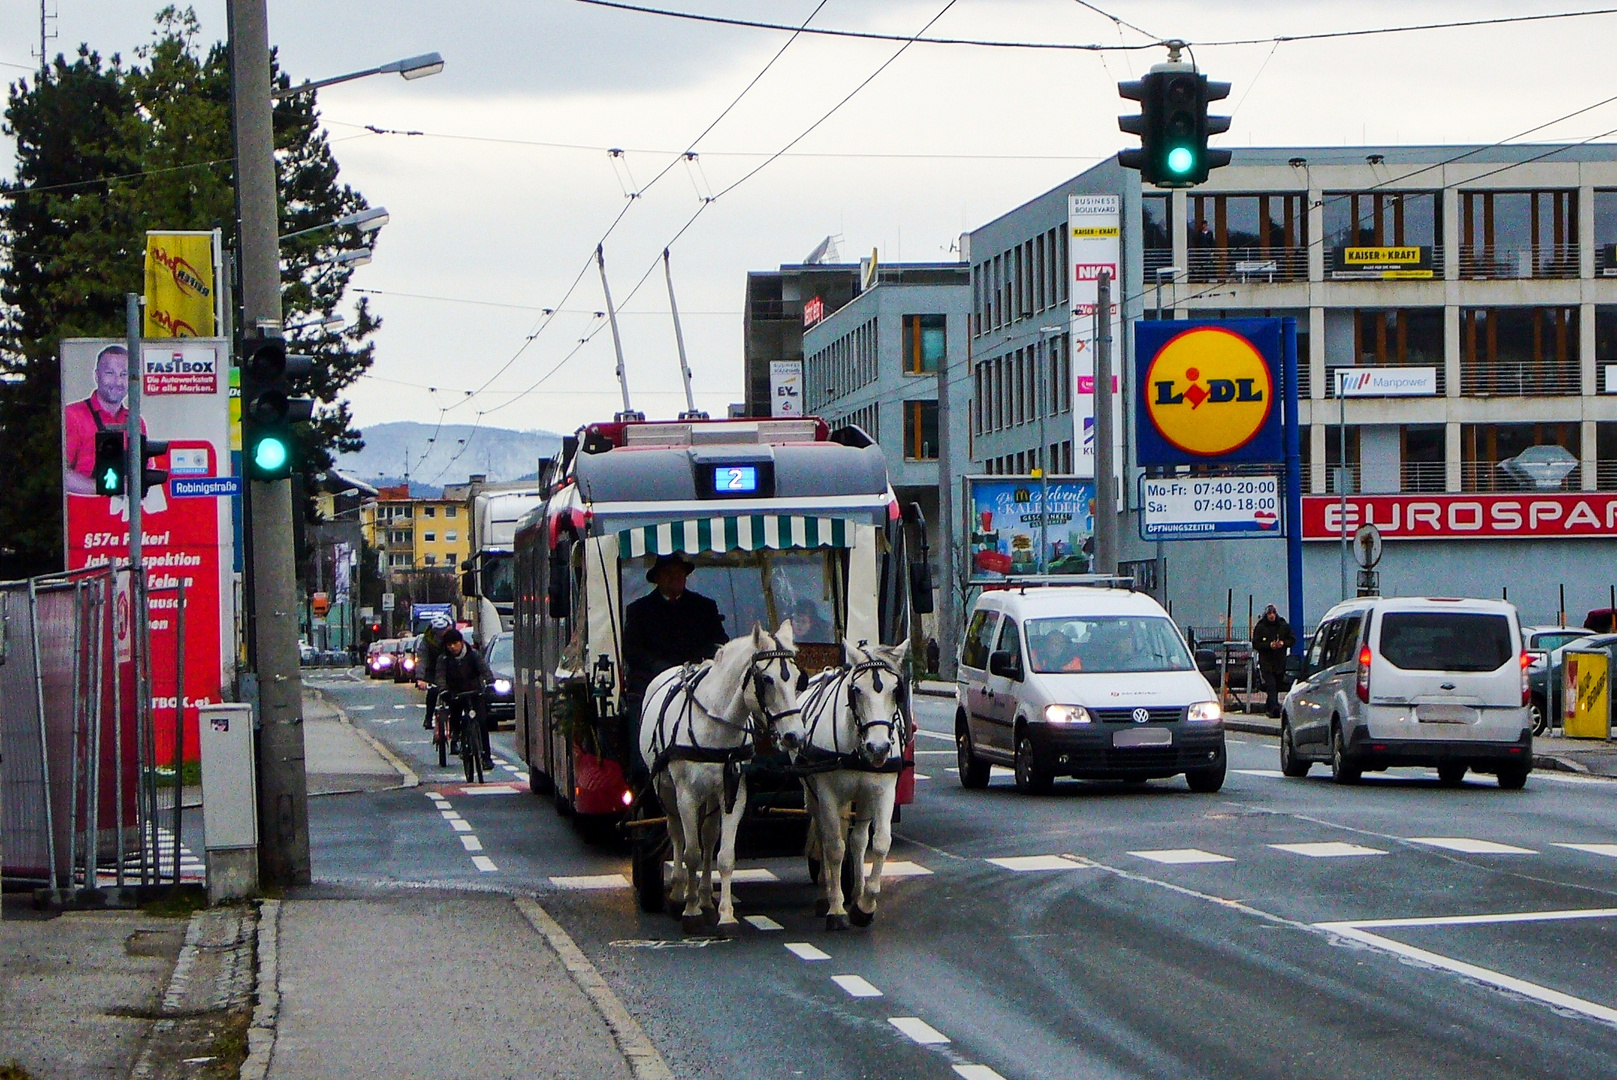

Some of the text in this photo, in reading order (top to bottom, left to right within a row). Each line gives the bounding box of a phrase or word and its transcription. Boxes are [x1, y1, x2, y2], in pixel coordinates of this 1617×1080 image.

[1075, 197, 1116, 206] BUSINESS
[1075, 206, 1116, 214] BOULEVARD
[147, 359, 213, 373] FASTBOX
[147, 384, 213, 392] für alle Marken.
[1373, 377, 1427, 388] Manpower
[778, 386, 794, 397] EY
[728, 469, 743, 488] 2
[176, 481, 237, 494] Robinigstraße
[1148, 481, 1275, 496] Mo-Fr: 07:40-20:00
[1005, 501, 1081, 514] KALENDER
[1148, 498, 1275, 513] Sa: 07:40-18:00
[1148, 523, 1215, 532] ÖFFNUNGSZEITEN
[84, 533, 119, 548] §57a
